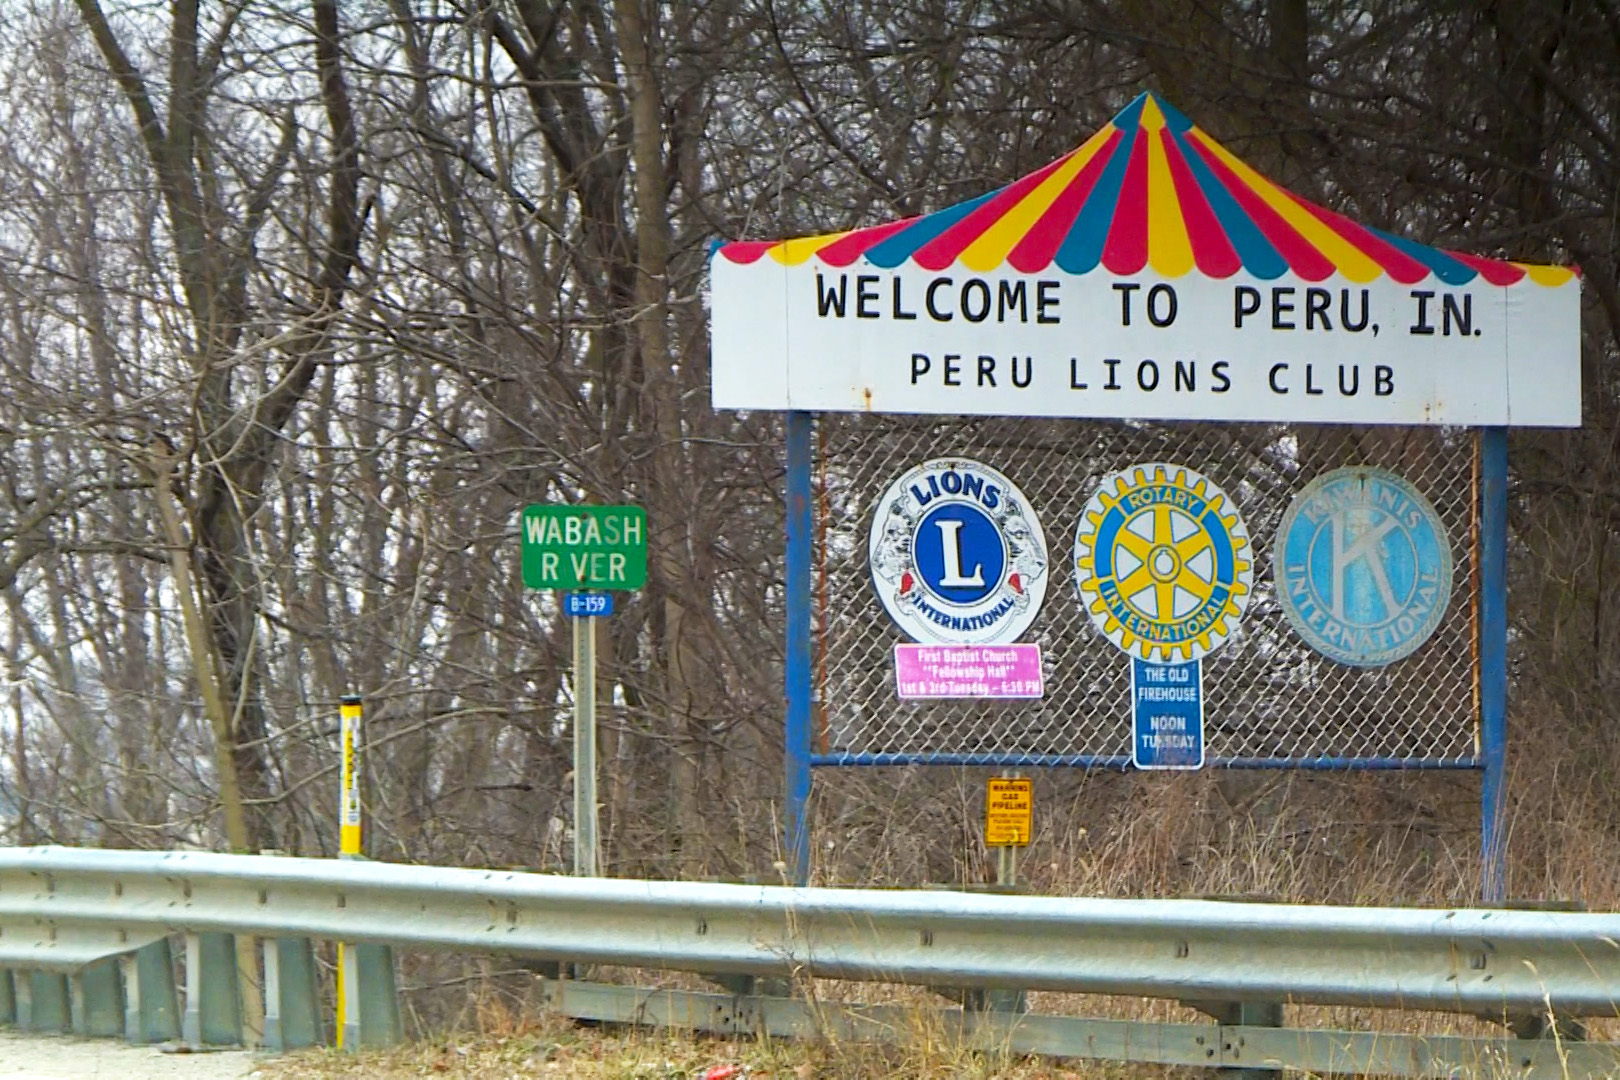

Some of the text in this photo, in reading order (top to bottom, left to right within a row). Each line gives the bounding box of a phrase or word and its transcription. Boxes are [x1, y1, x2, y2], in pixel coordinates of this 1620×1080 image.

[817, 273, 1482, 337] WELCOME TO PERU, IN.
[911, 354, 1395, 397] PERU LIONS CLUB
[910, 471, 1001, 509] LIONS
[1128, 486, 1201, 508] ROTARY
[1303, 481, 1422, 528] KIWANIS
[525, 515, 641, 545] WABASH
[542, 552, 626, 581] RVER
[935, 520, 986, 587] L
[1333, 511, 1401, 622] K
[912, 595, 1015, 631] INTERNATIONAL
[1102, 586, 1227, 642] INTERNATIONAL
[1288, 565, 1439, 652] INTERNATIONAL
[917, 649, 1018, 664] First Baptist Church
[1144, 667, 1189, 682] THE OLD
[1138, 687, 1197, 701] FIREHOUSE
[1150, 716, 1187, 730] NOON
